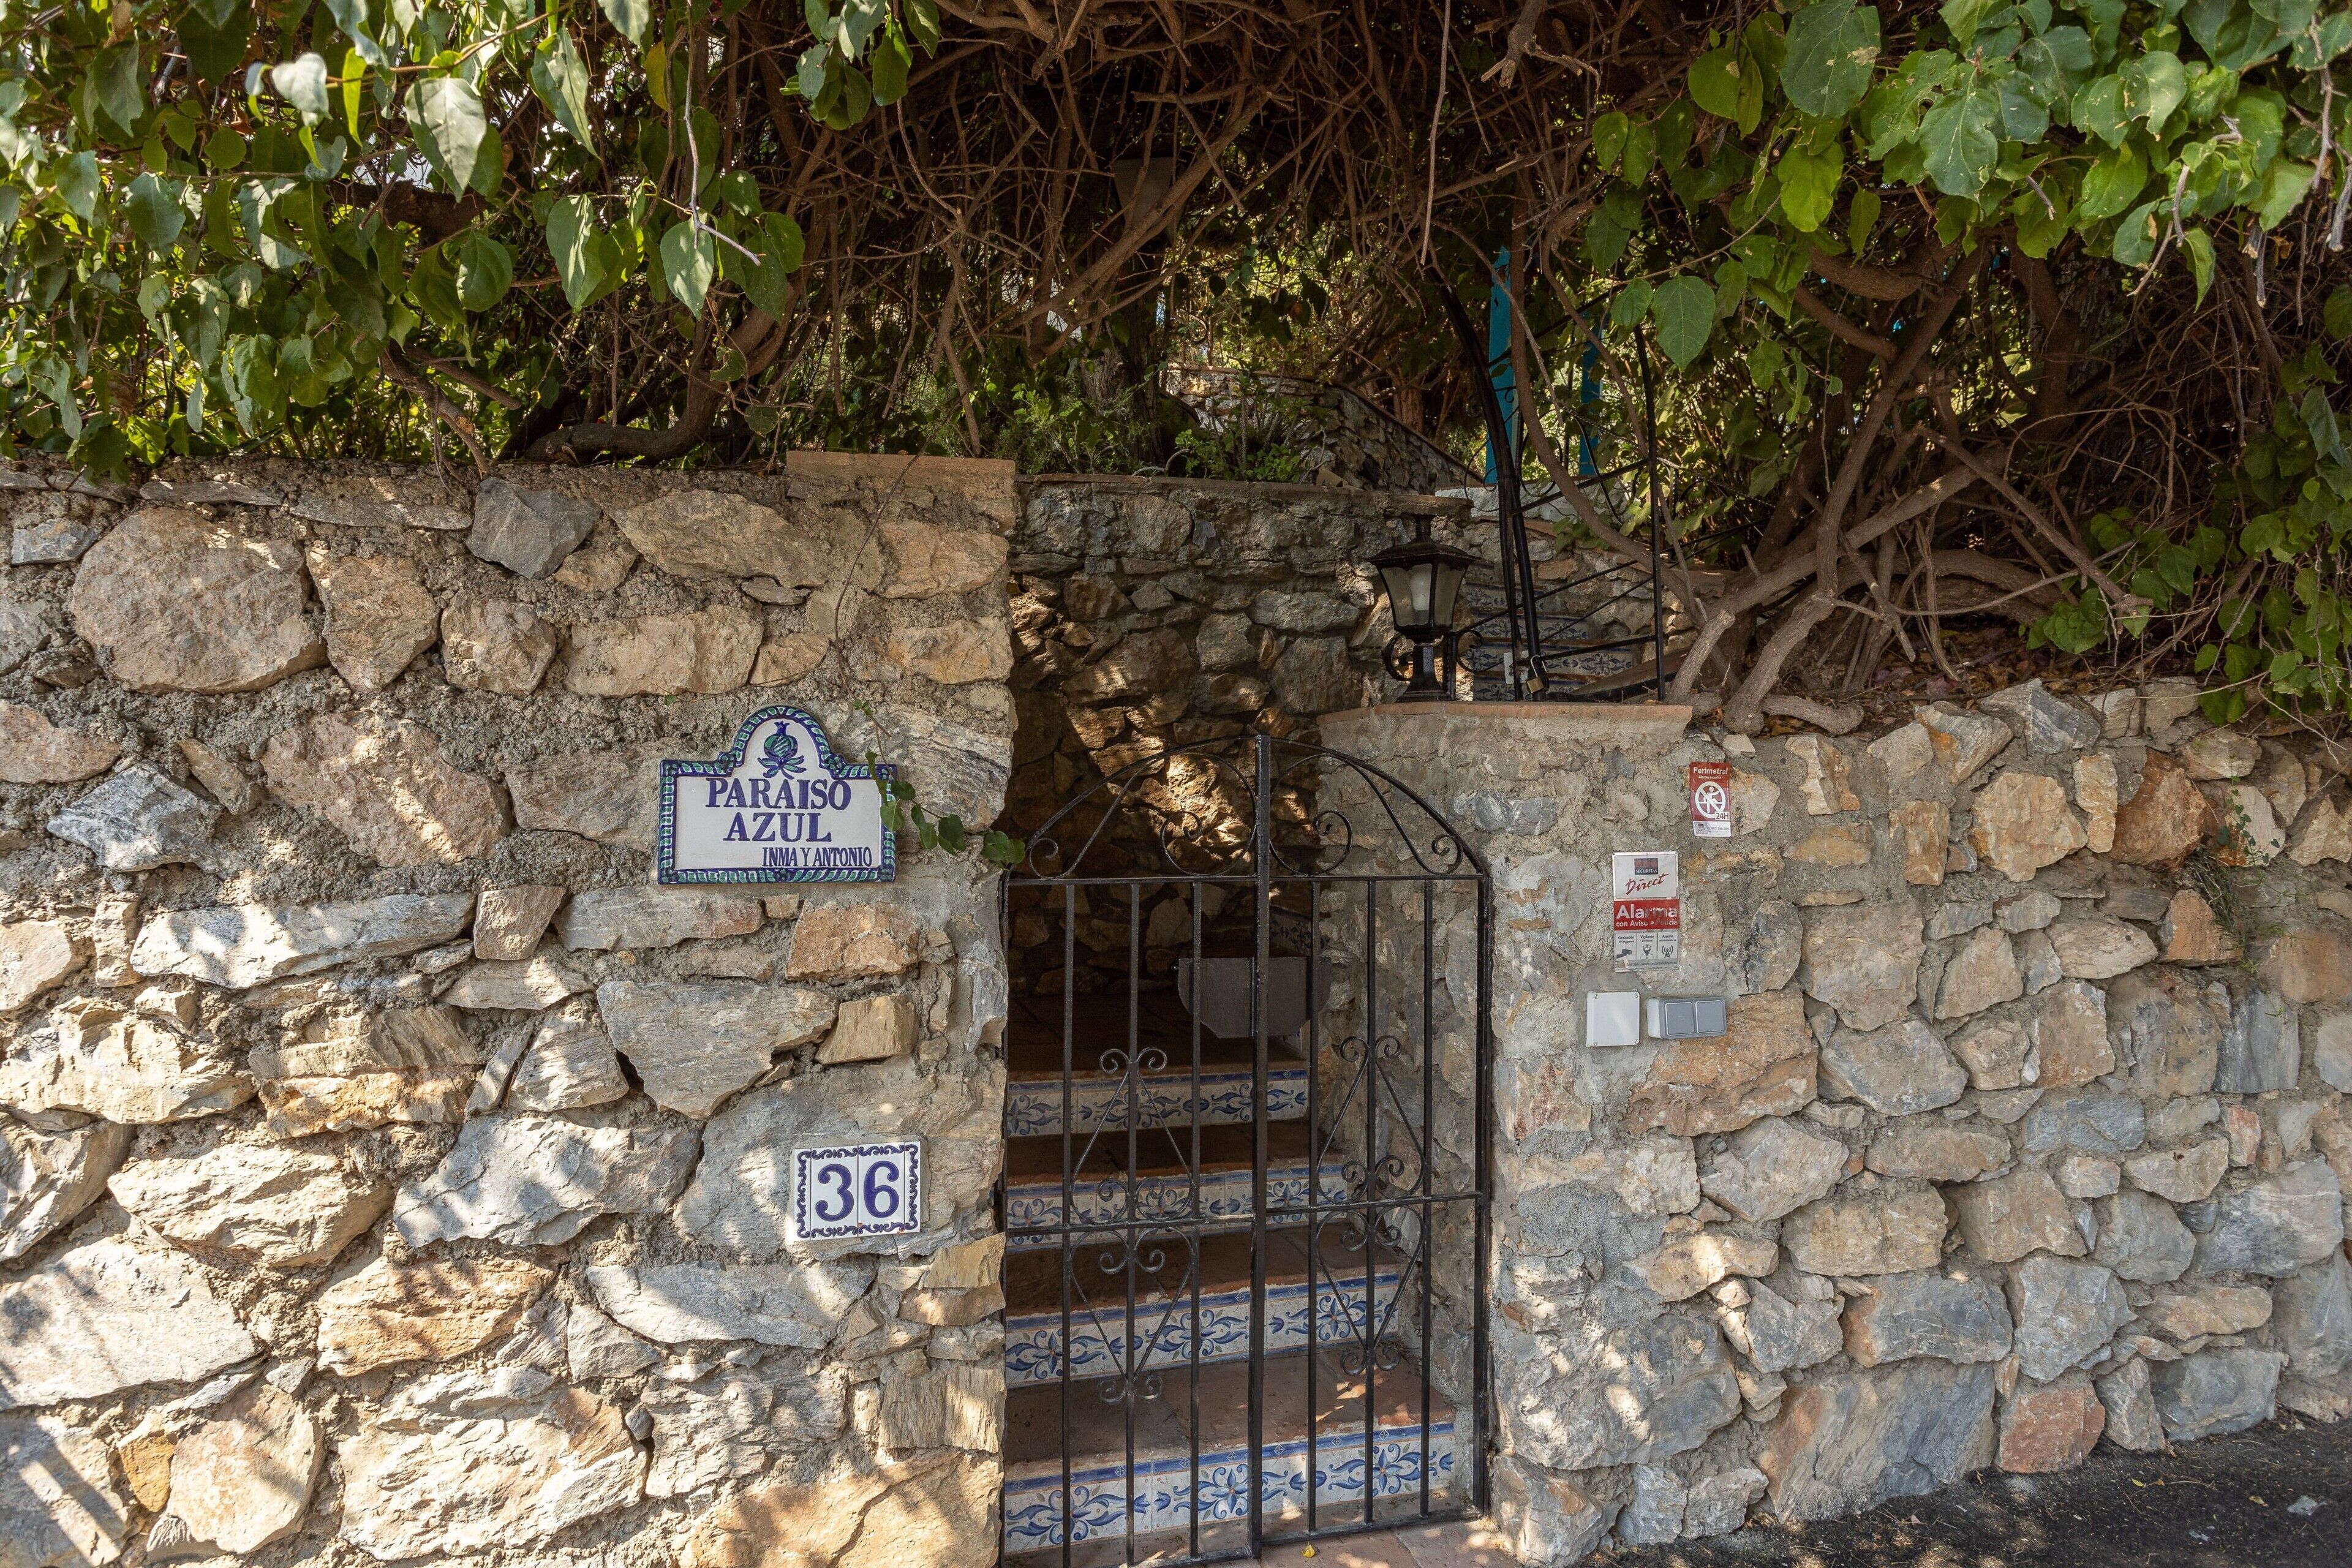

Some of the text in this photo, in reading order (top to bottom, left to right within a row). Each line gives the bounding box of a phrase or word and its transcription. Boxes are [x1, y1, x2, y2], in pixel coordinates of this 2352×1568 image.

[1693, 766, 1728, 775] Perimetral
[705, 777, 851, 810] PARAISO
[723, 812, 832, 842] AZUL
[762, 846, 873, 867] INMA Y ANTONIO
[1625, 872, 1670, 895] Direct
[1616, 903, 1678, 919] Alarma
[815, 1160, 899, 1222] 36
